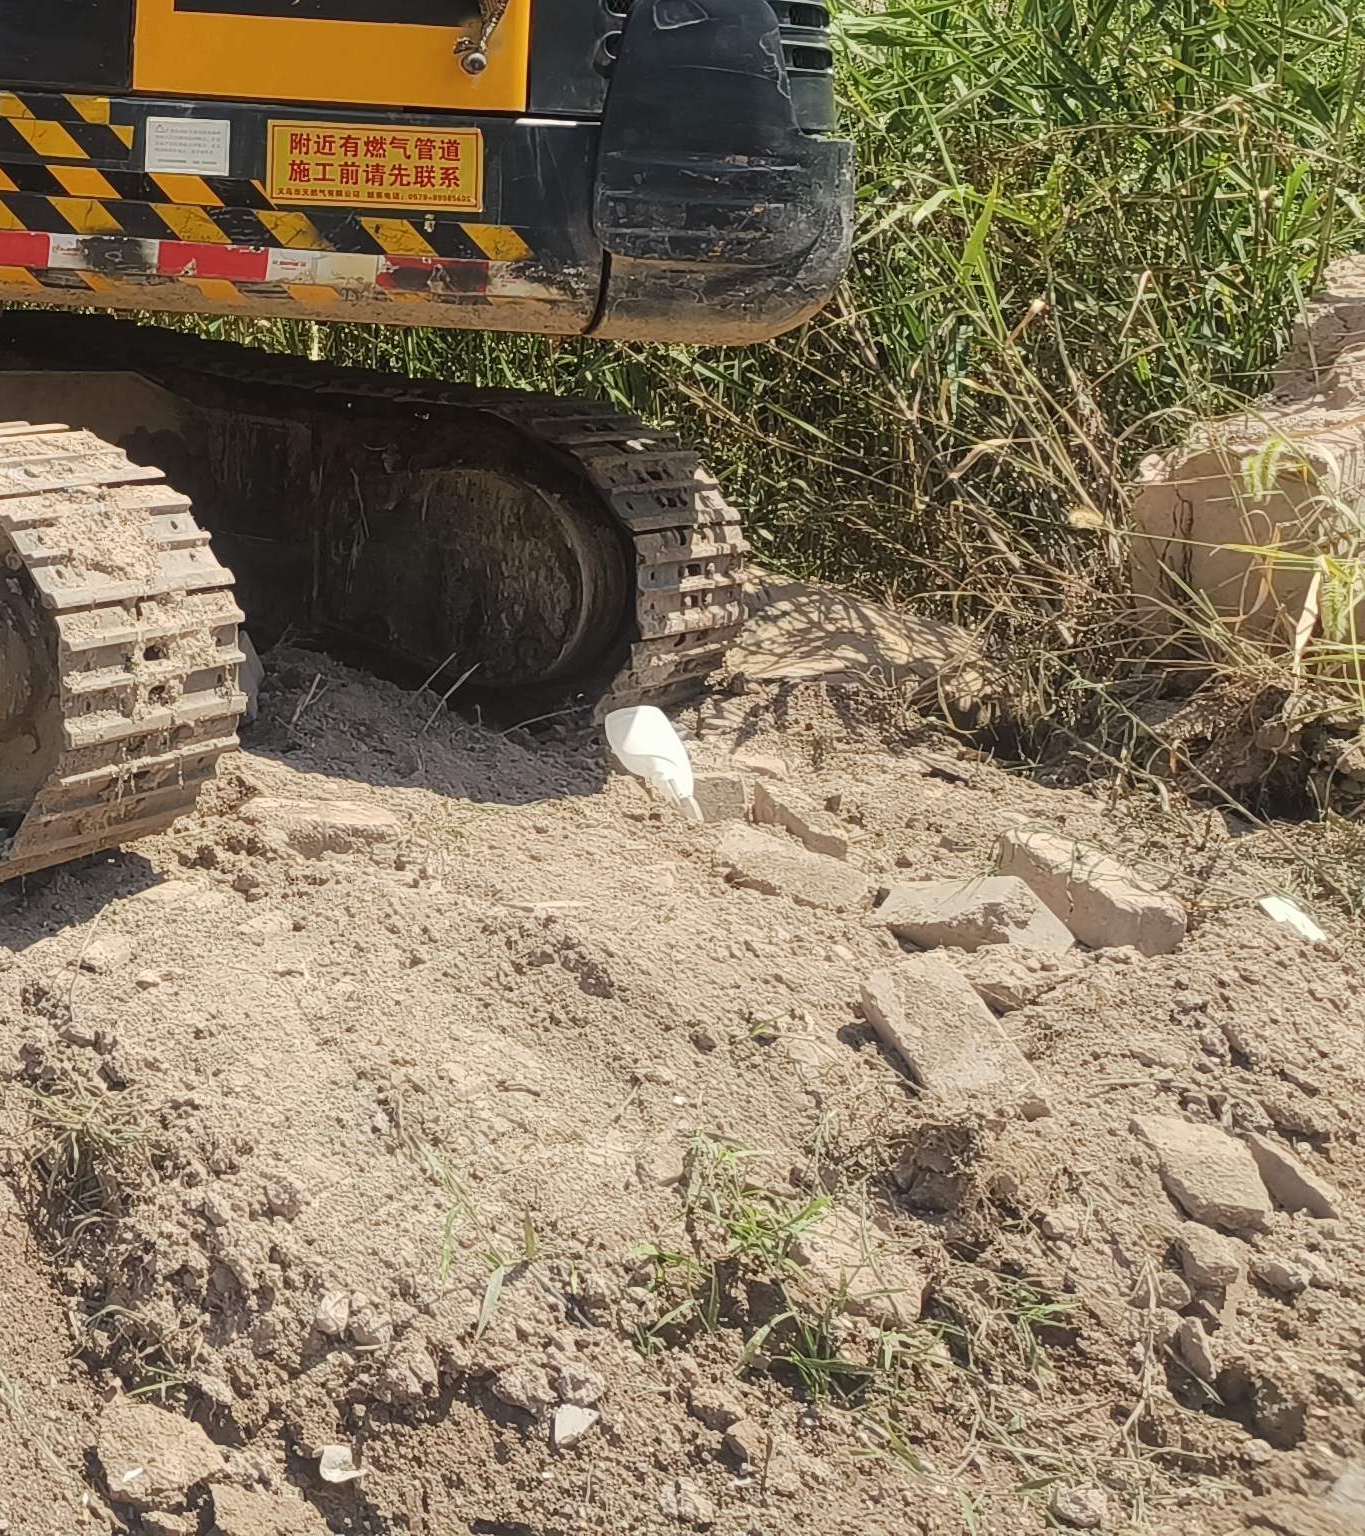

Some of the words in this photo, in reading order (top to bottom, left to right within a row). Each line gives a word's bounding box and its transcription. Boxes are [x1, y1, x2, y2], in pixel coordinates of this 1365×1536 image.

[289, 132, 461, 162] 附近有燃气管道
[288, 160, 460, 189] 施工前请先联系
